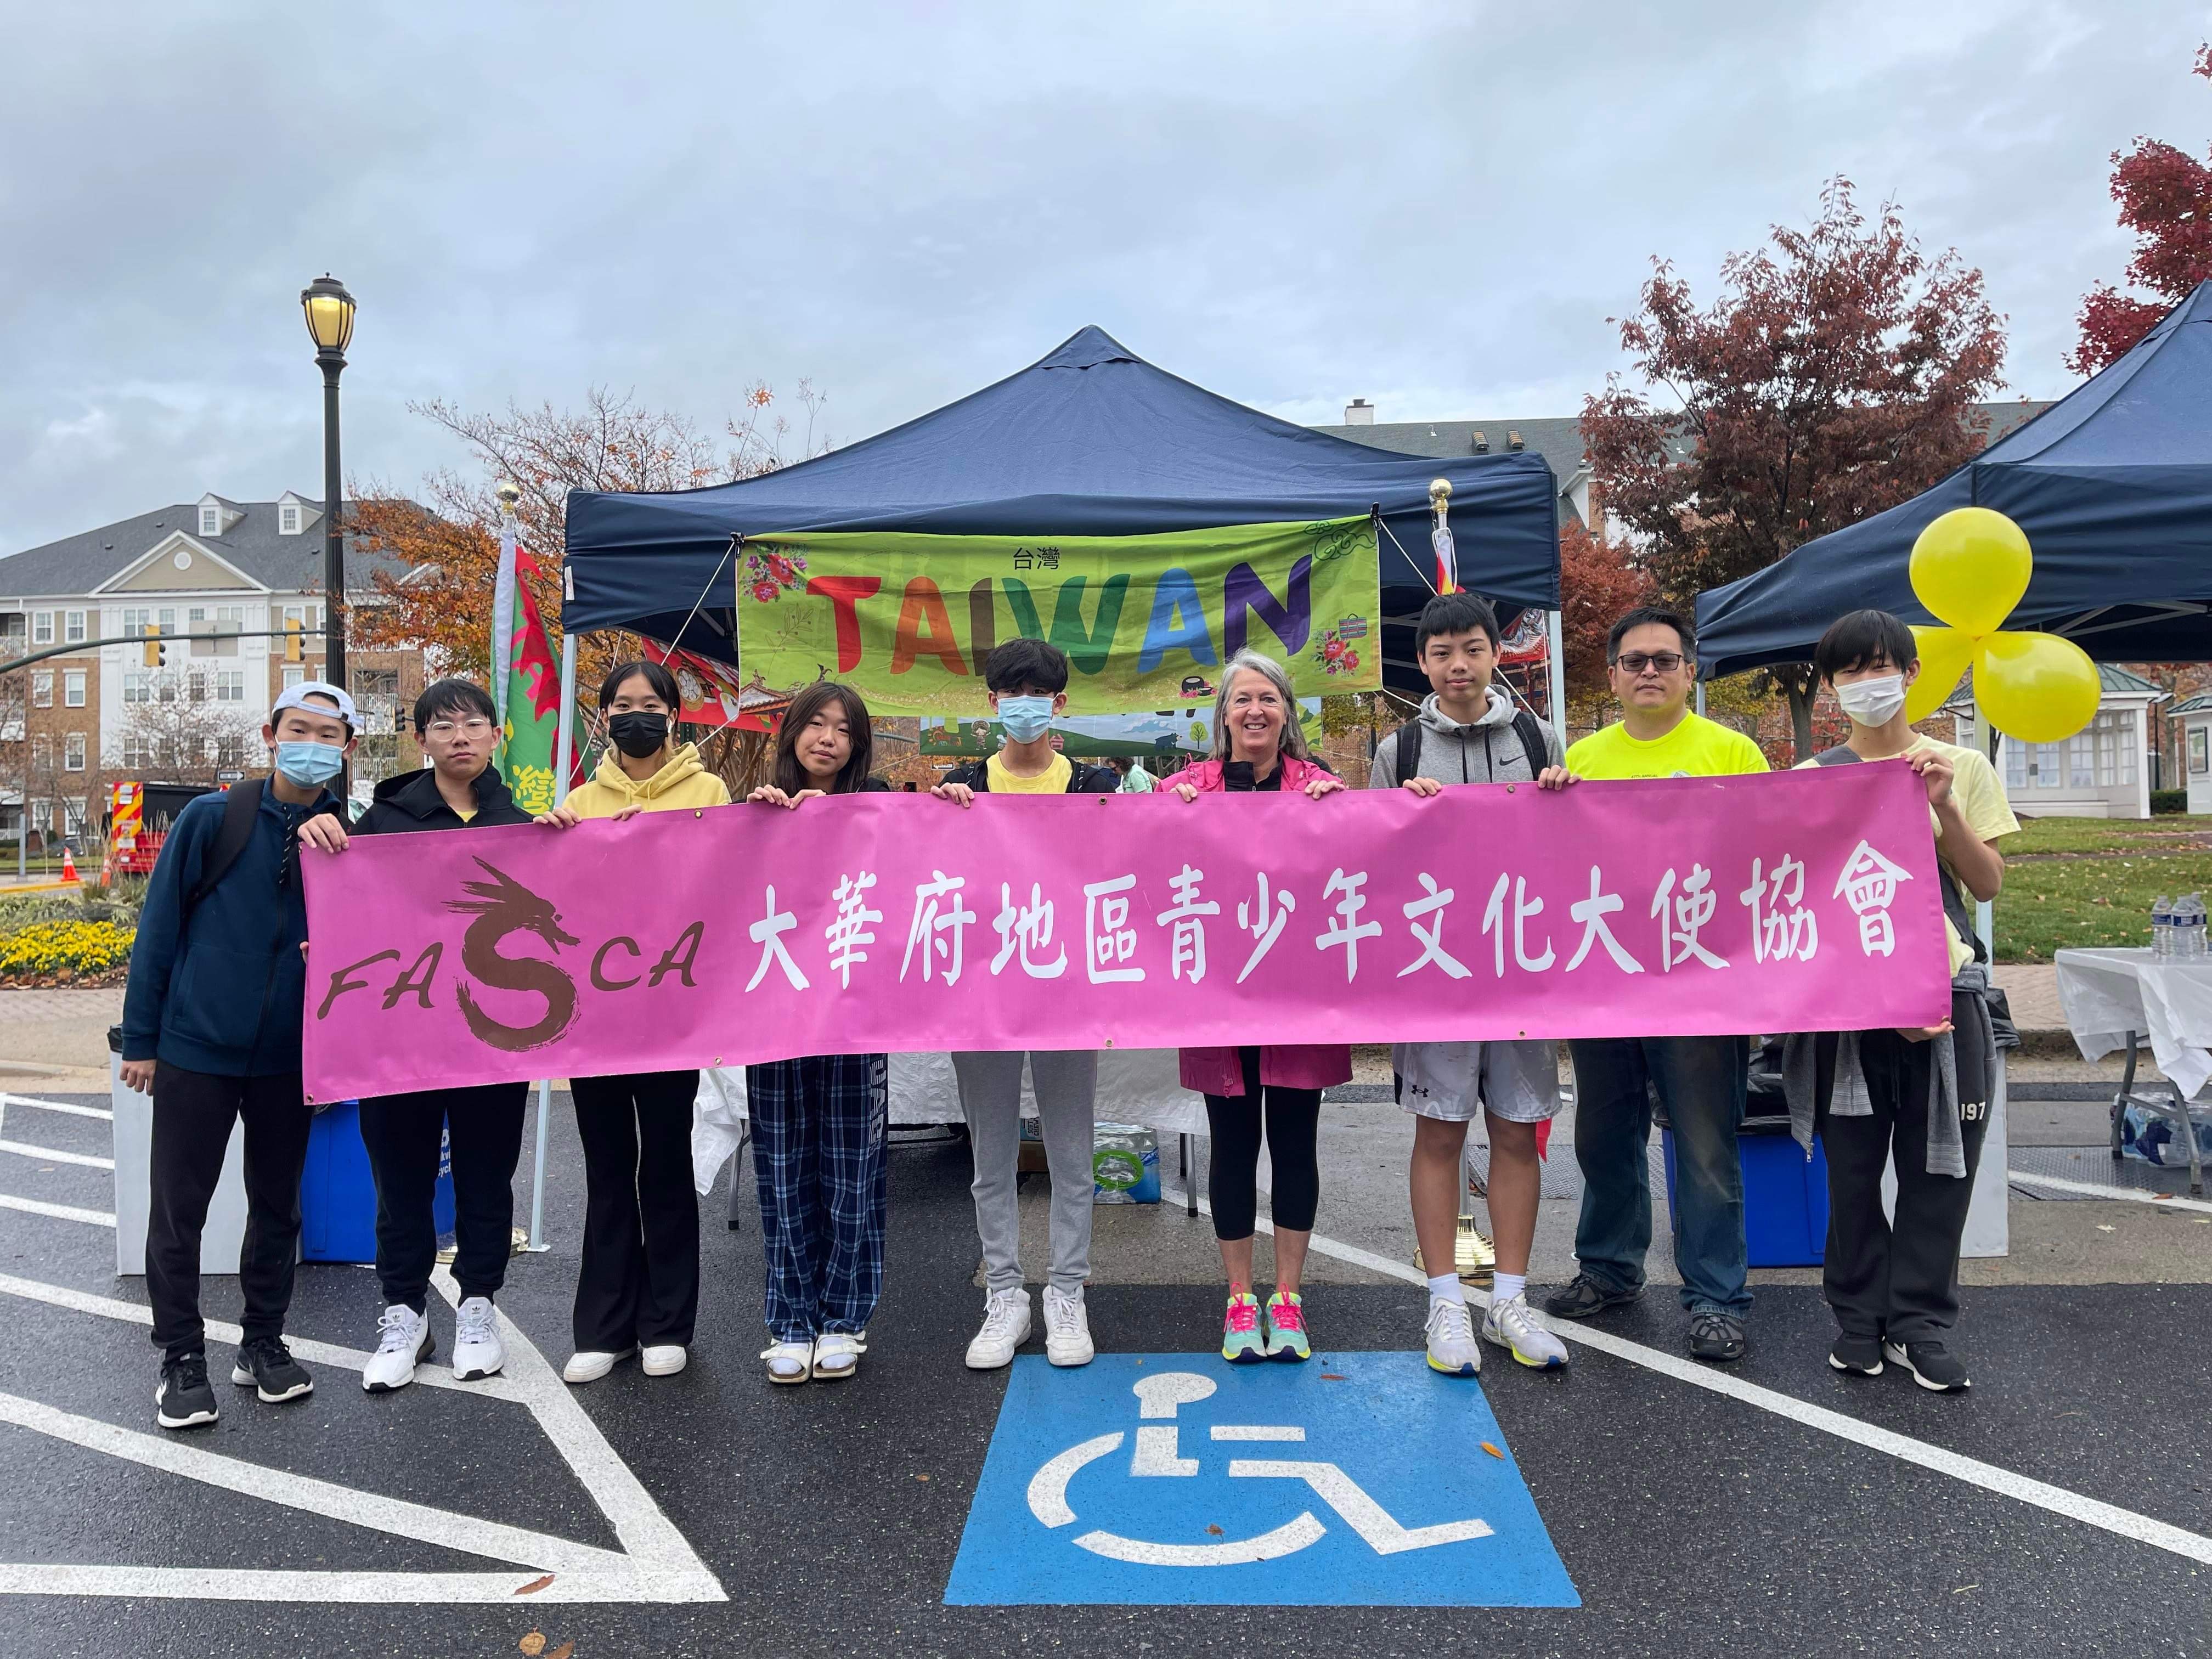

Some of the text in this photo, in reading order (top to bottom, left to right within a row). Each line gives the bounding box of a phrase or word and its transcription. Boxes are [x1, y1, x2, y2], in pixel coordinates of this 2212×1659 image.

[806, 554, 1312, 675] TAIWAN
[1013, 547, 1060, 569] 台灣
[316, 855, 704, 1052] FASCA
[745, 839, 1913, 992] 大華府地區青少年文化大使協會
